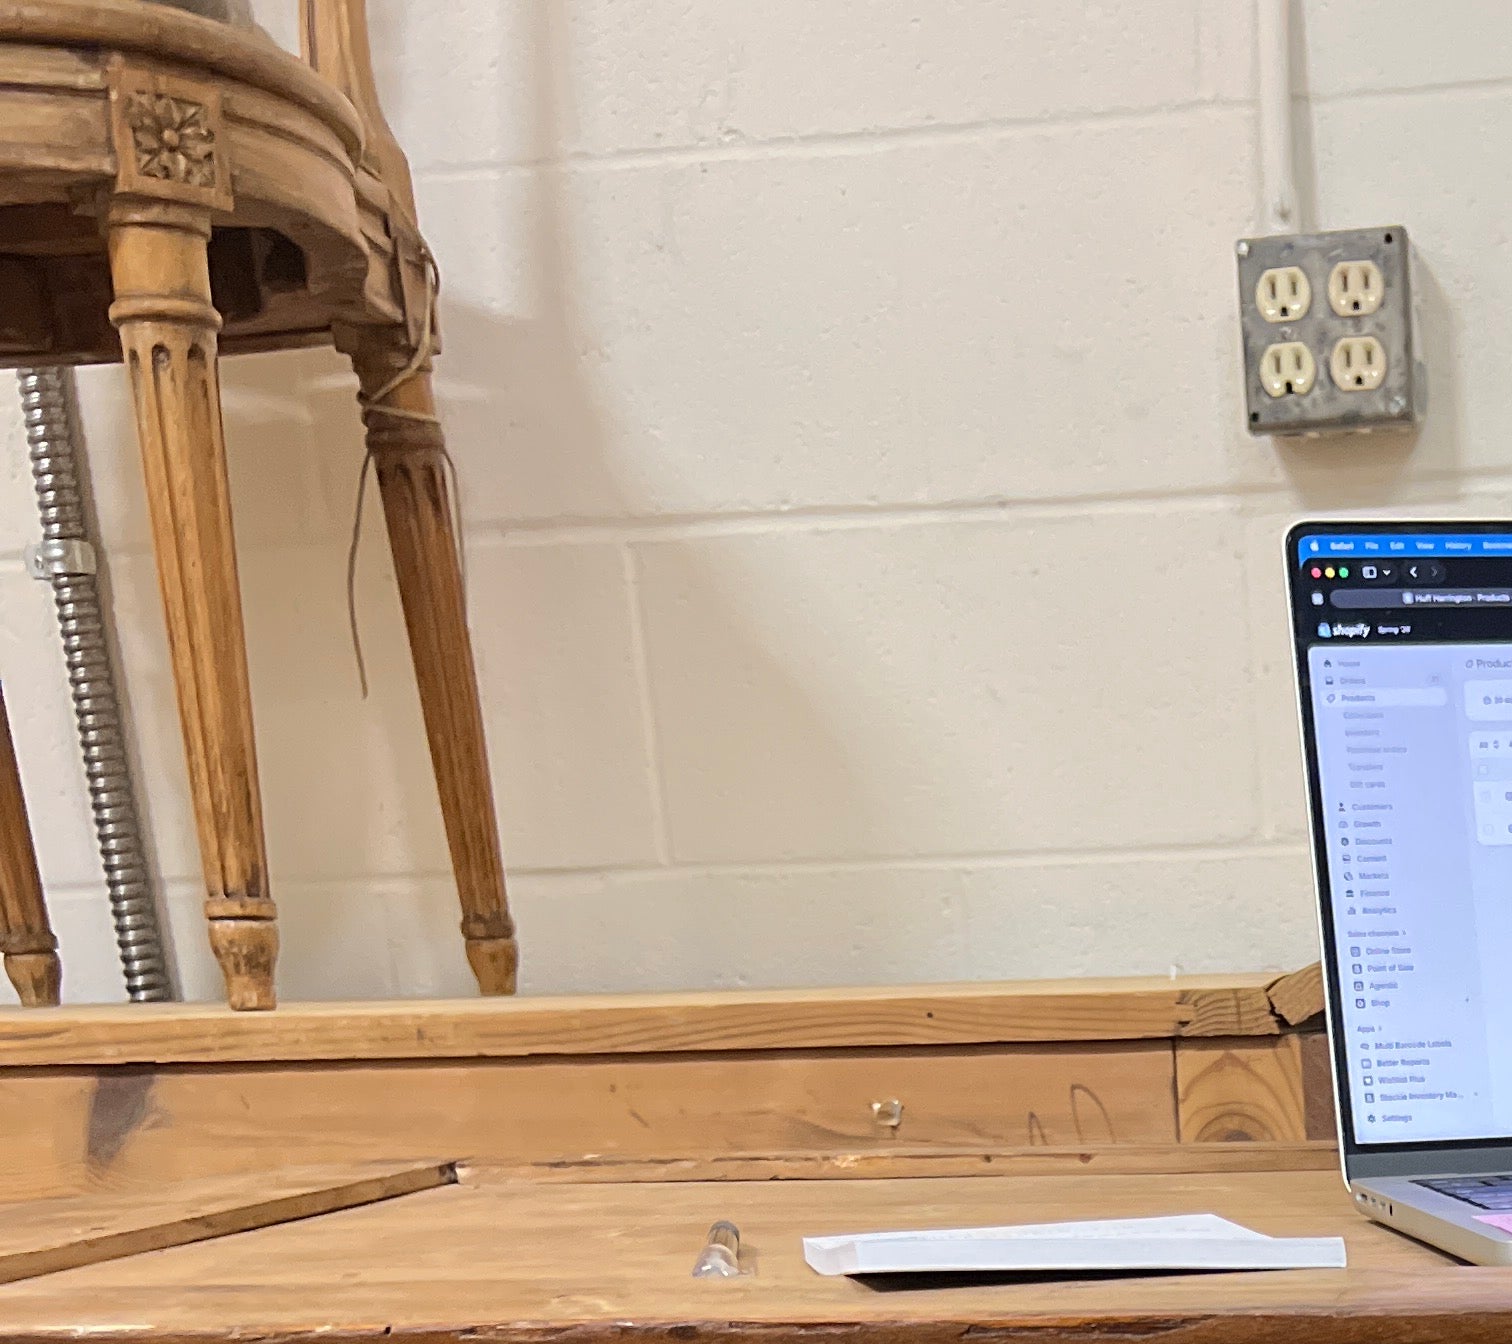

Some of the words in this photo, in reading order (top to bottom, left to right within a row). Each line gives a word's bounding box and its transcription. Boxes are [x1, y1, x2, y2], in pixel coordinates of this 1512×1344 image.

[1332, 623, 1370, 638] shopify
[1395, 1041, 1426, 1049] Barcode
[1382, 1114, 1412, 1123] Settings
